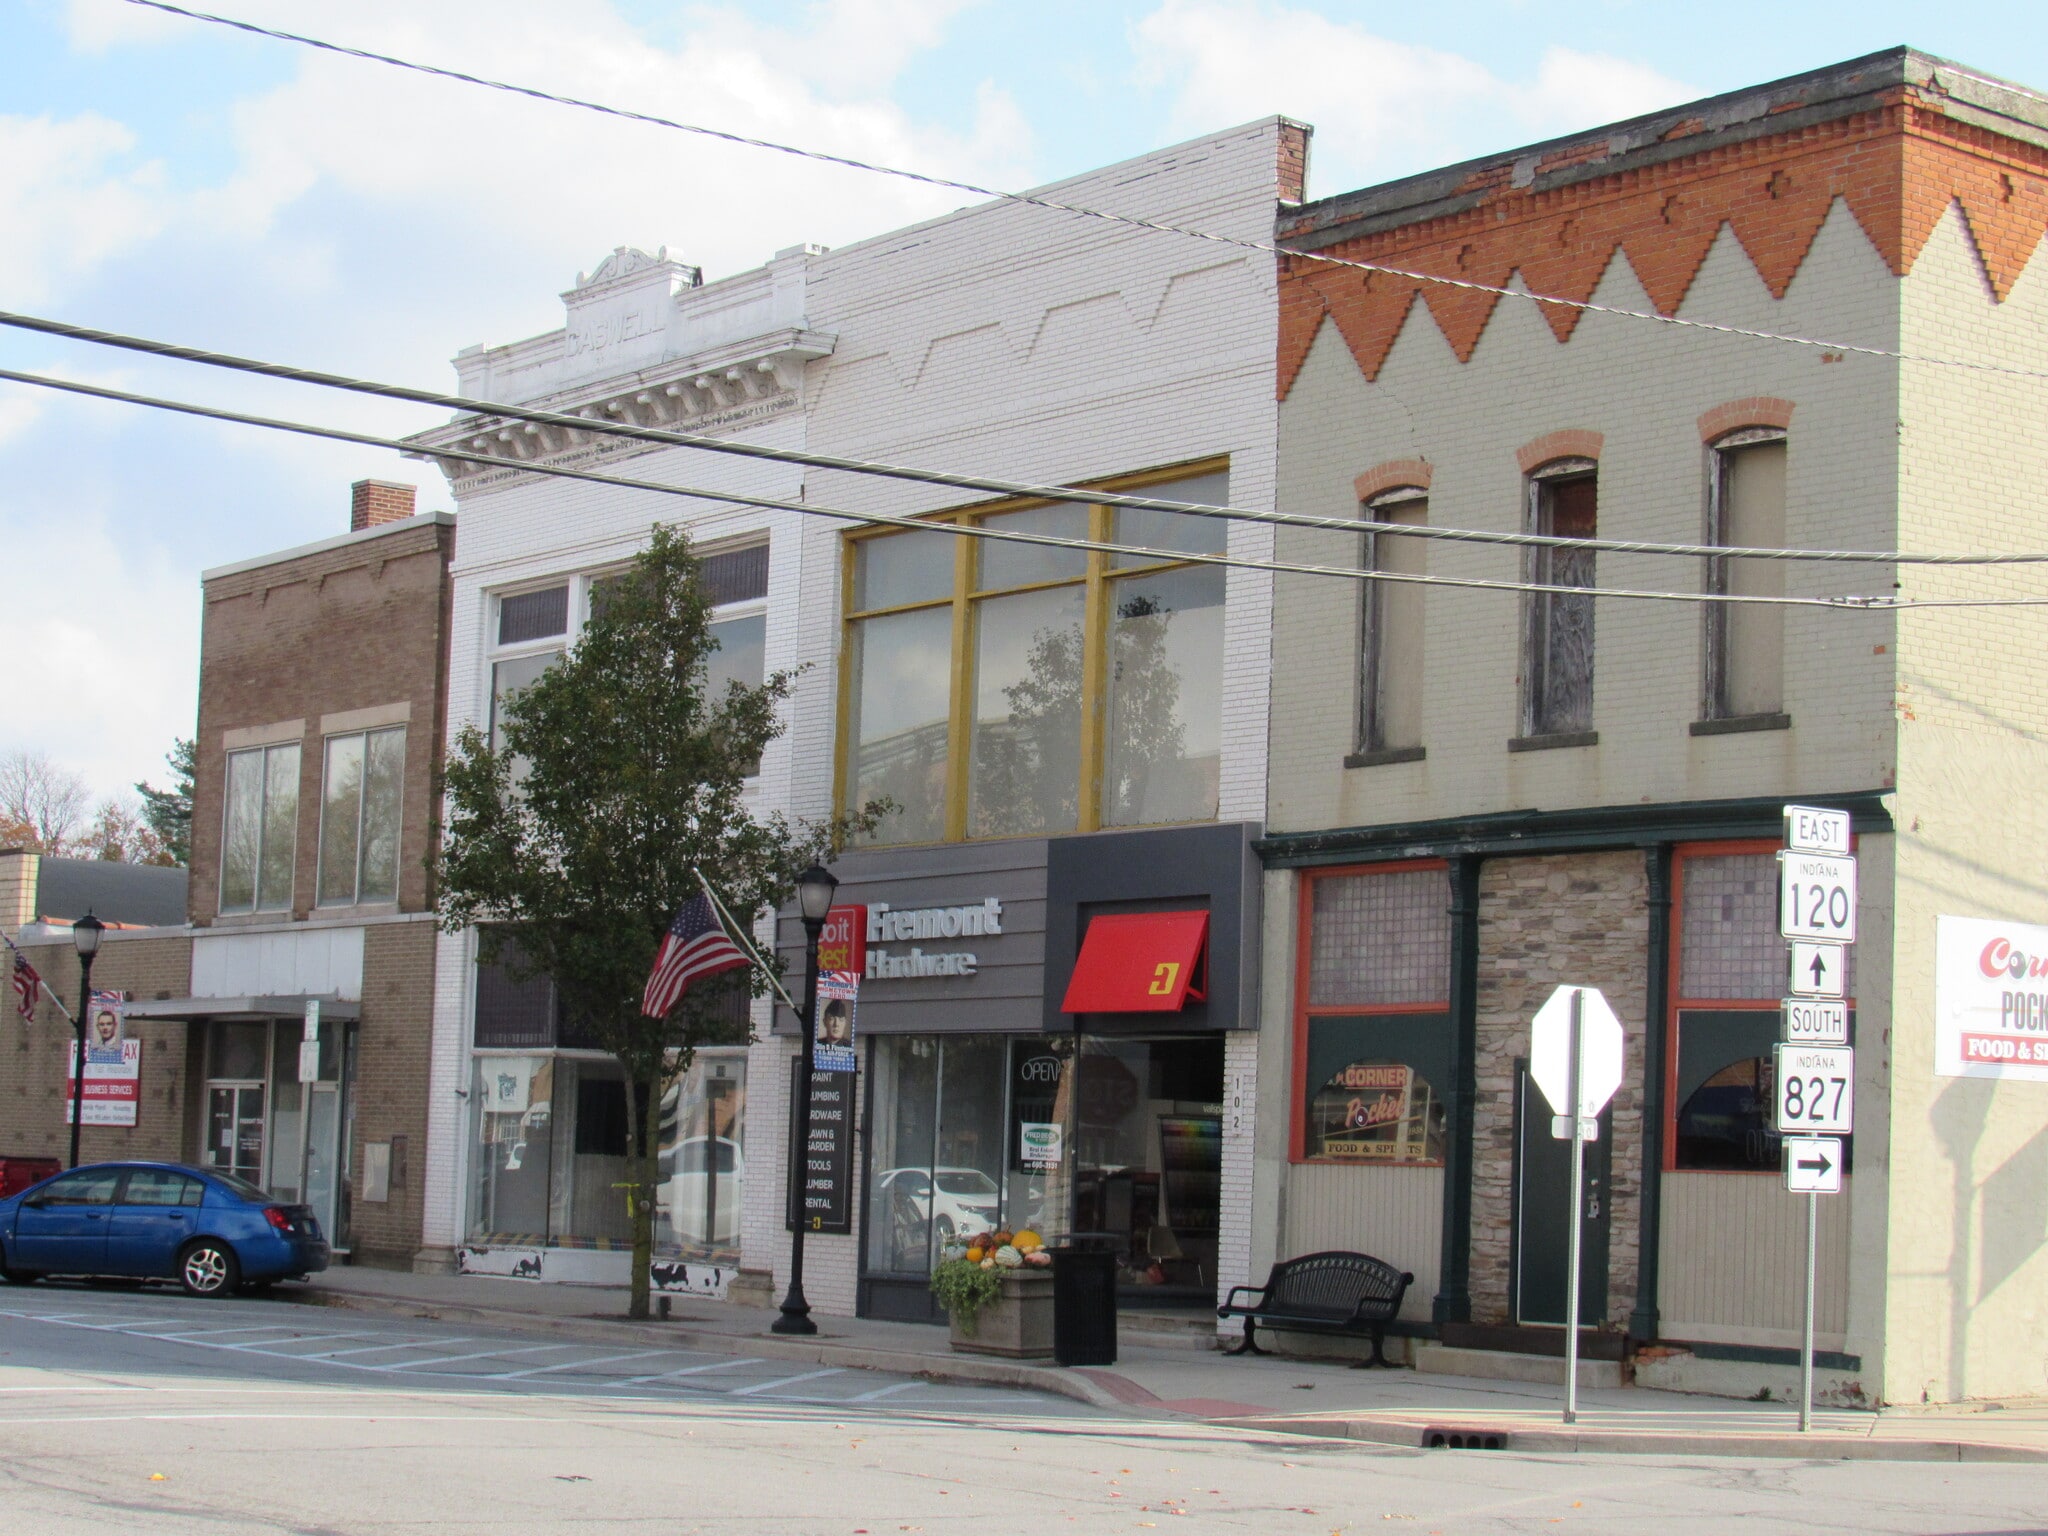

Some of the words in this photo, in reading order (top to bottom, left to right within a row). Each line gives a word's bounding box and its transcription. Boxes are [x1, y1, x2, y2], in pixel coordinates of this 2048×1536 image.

[564, 309, 666, 358] CASWELL
[1799, 814, 1841, 844] EAST
[1799, 862, 1840, 879] INDIANA
[1791, 883, 1850, 929] 120
[866, 897, 1002, 942] Fremont
[865, 947, 979, 980] Hardware
[1791, 1006, 1842, 1034] SOUTH
[123, 1043, 138, 1060] AX
[1967, 1037, 2014, 1059] FOOD
[2017, 1041, 2031, 1060] &
[1021, 1060, 1060, 1081] OPEN
[1796, 1055, 1836, 1070] INDIANA
[811, 1072, 833, 1082] PAINT
[1345, 1068, 1407, 1087] CORNER
[84, 1084, 108, 1095] BUSINESS
[109, 1084, 133, 1096] SERVICES
[810, 1091, 840, 1102] UMBING
[1784, 1075, 1847, 1122] 827
[809, 1109, 842, 1121] RDWARE
[1344, 1091, 1406, 1128] Pocket
[1040, 1131, 1056, 1140] BECK
[1328, 1143, 1358, 1153] FOOD
[1362, 1143, 1371, 1153] &
[1375, 1143, 1422, 1154] SPITS
[808, 1160, 832, 1171] TOOLS
